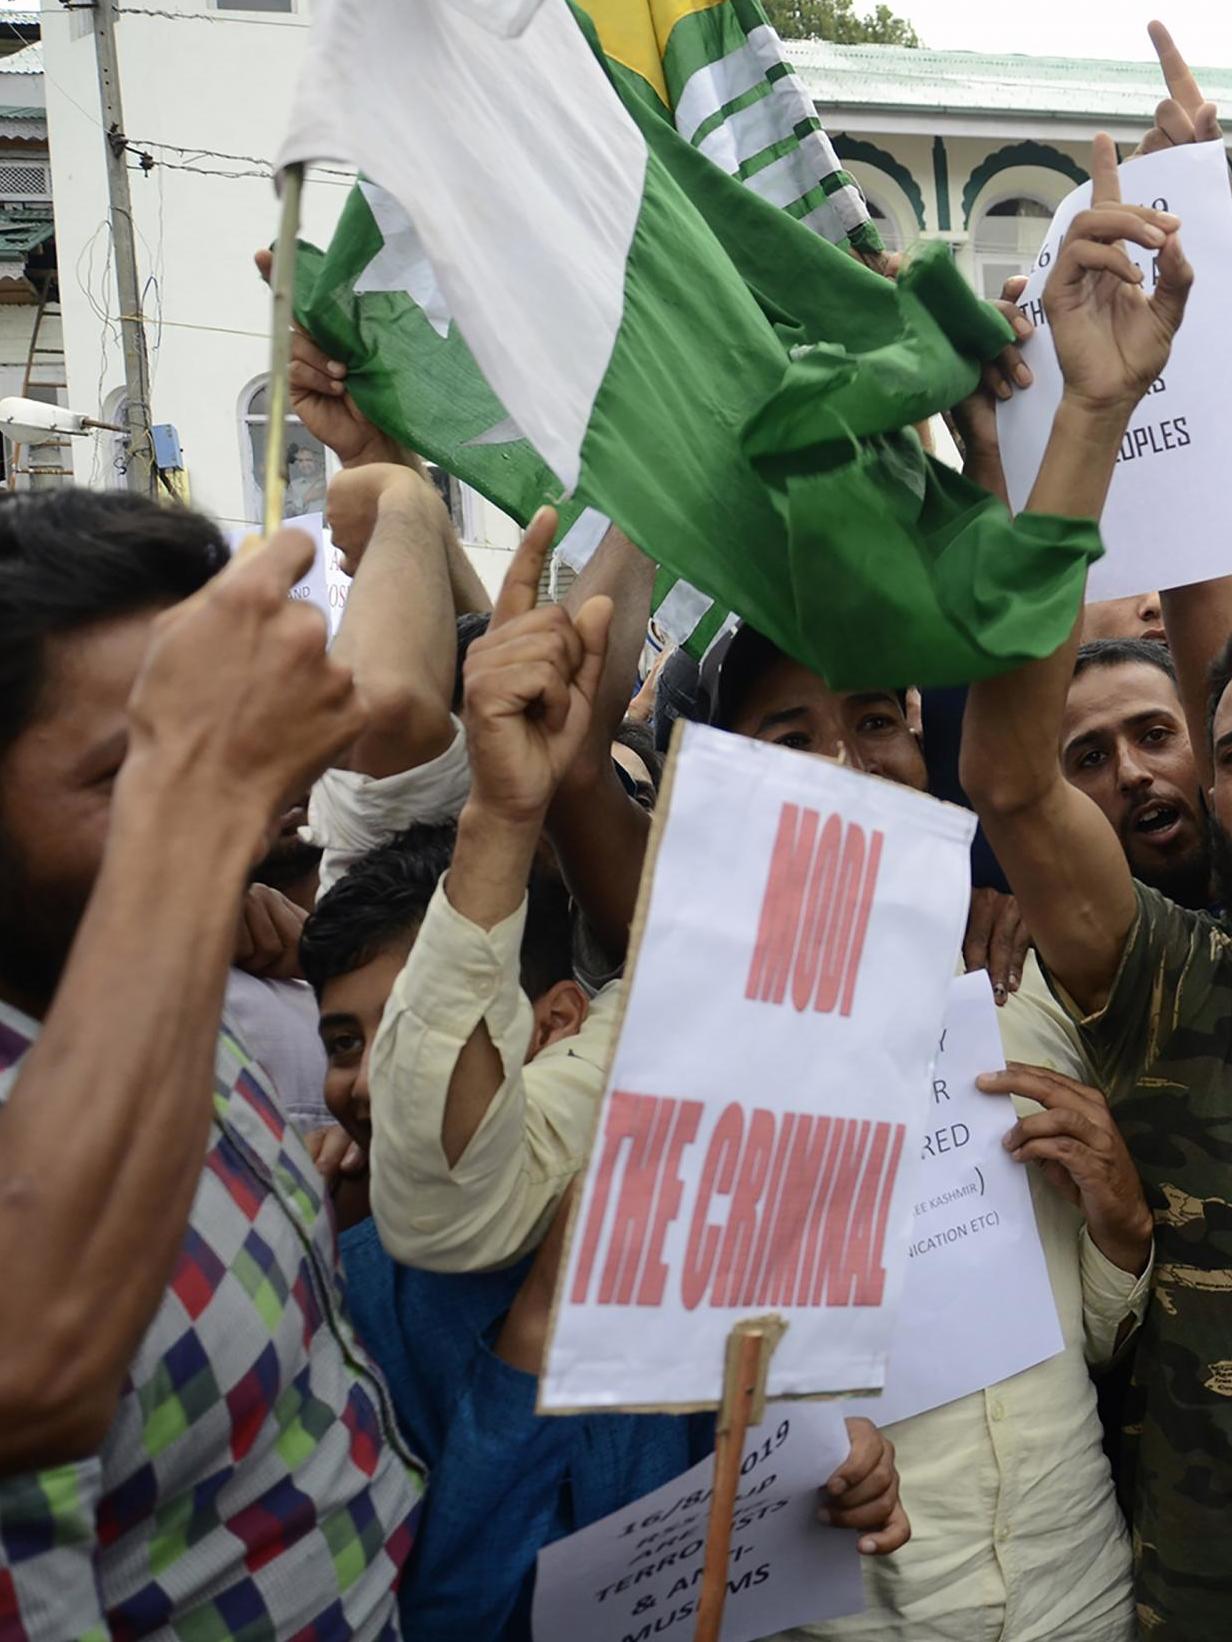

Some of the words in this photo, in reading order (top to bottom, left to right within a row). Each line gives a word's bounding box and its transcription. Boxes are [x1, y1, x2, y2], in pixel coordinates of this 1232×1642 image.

[1118, 417, 1191, 462] OPLES
[744, 802, 884, 1018] MODI
[570, 1090, 705, 1308] THE
[681, 1101, 906, 1311] CRIMINAL
[970, 1210, 1000, 1233] ETC)
[617, 1420, 790, 1540] 16/8/019
